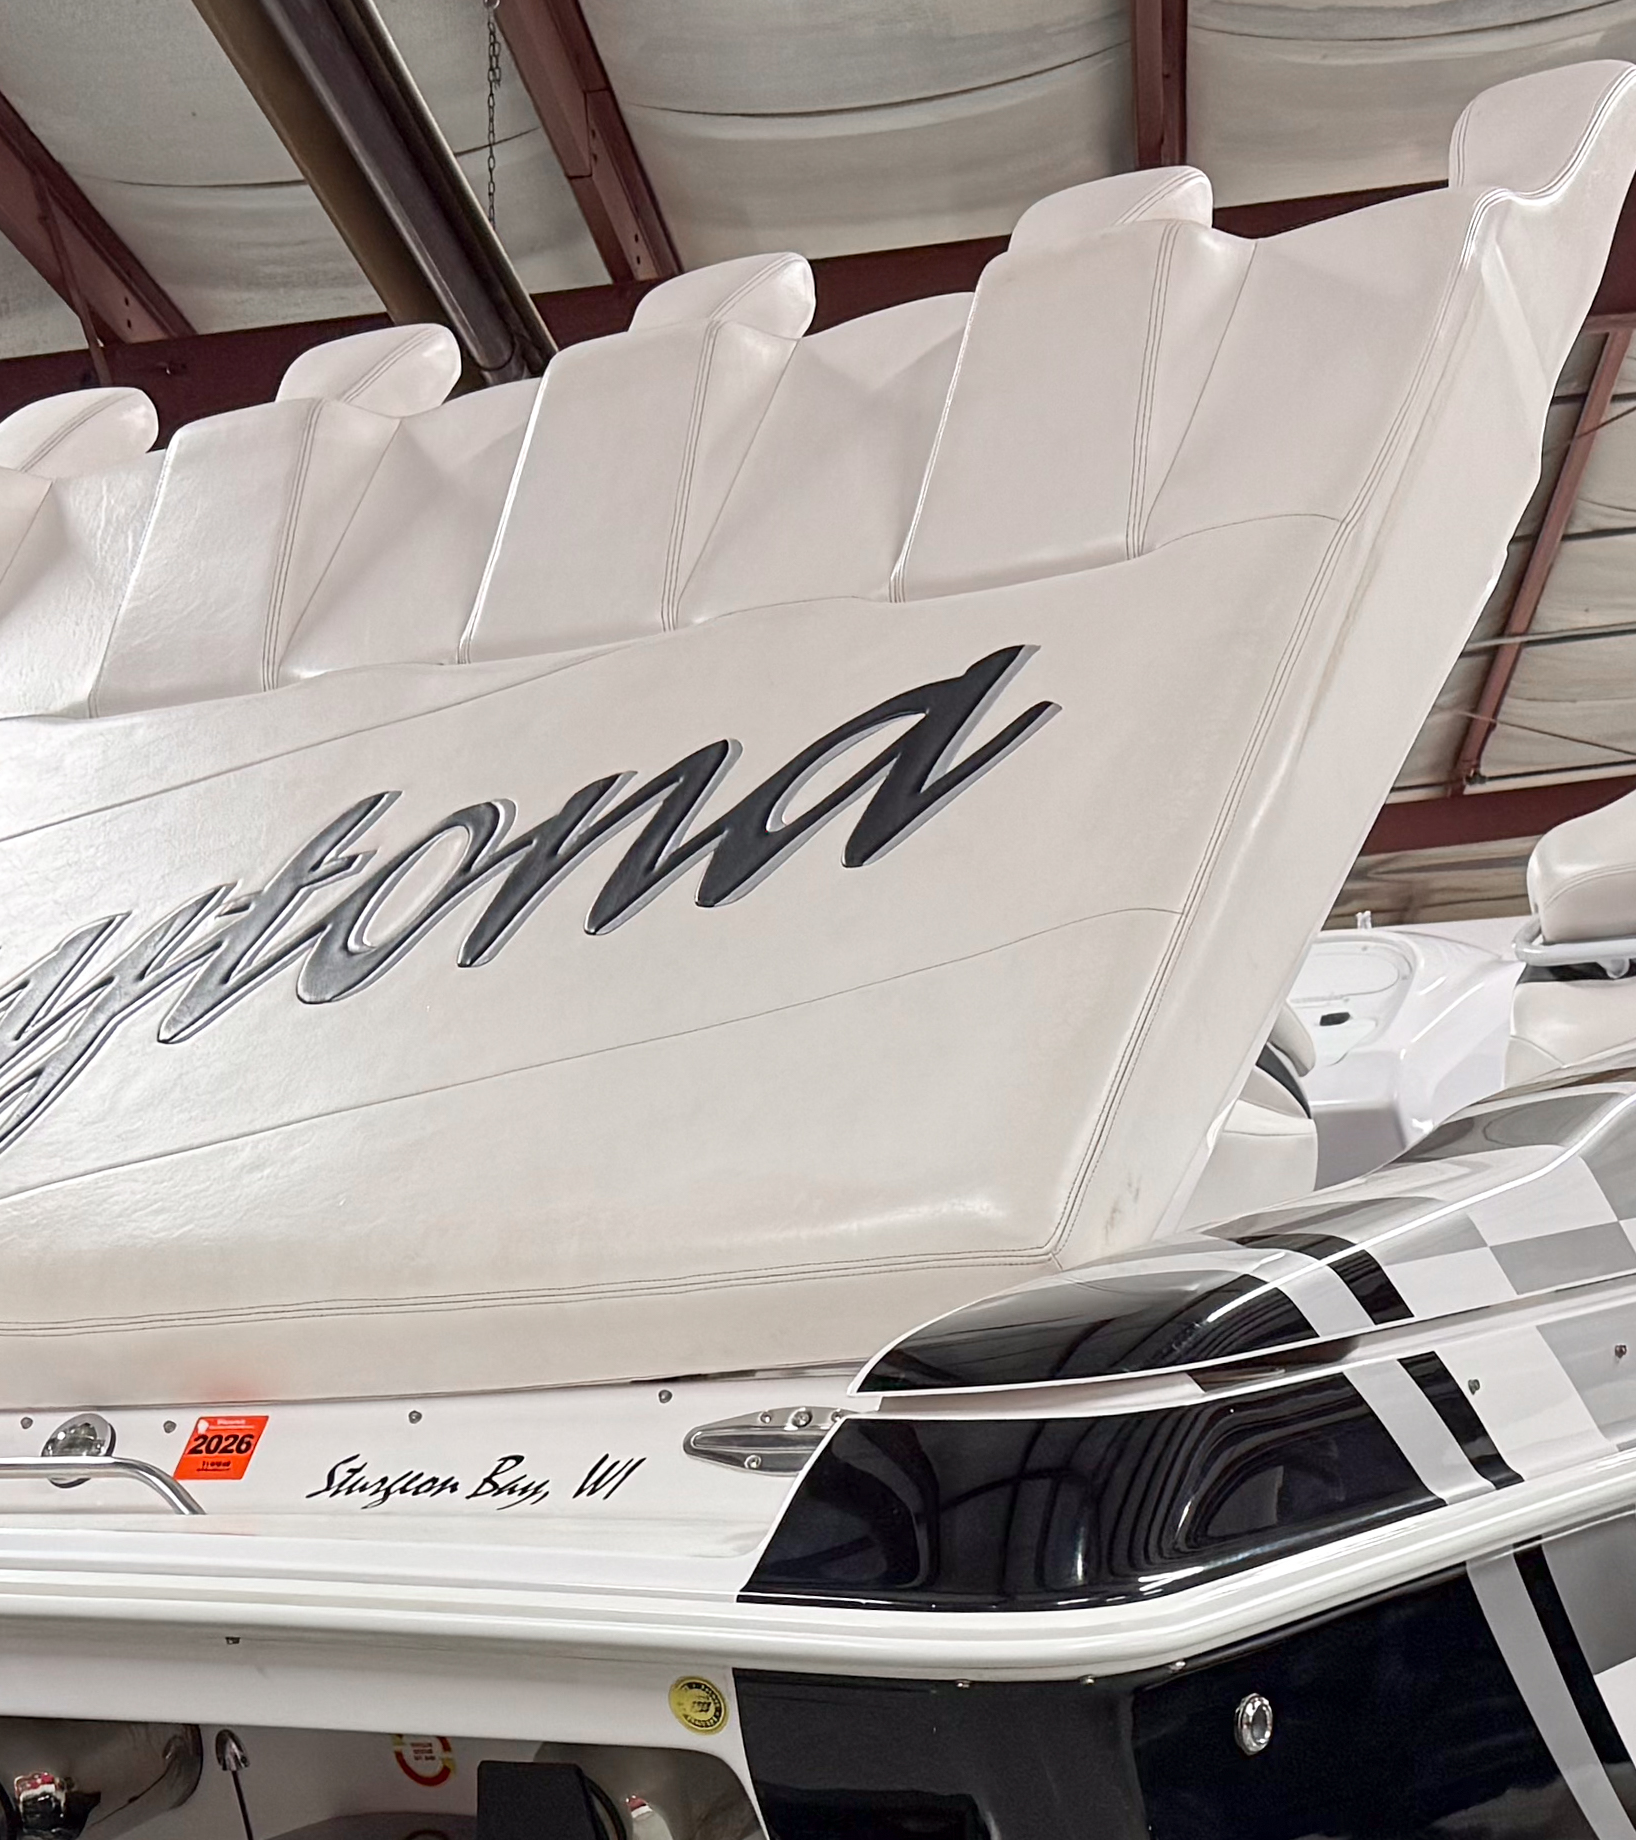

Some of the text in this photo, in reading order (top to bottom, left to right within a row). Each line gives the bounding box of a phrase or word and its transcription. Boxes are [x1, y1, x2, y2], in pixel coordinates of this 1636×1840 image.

[187, 1434, 255, 1455] 2026
[305, 1453, 647, 1511] Sturgeon Bay, WI
